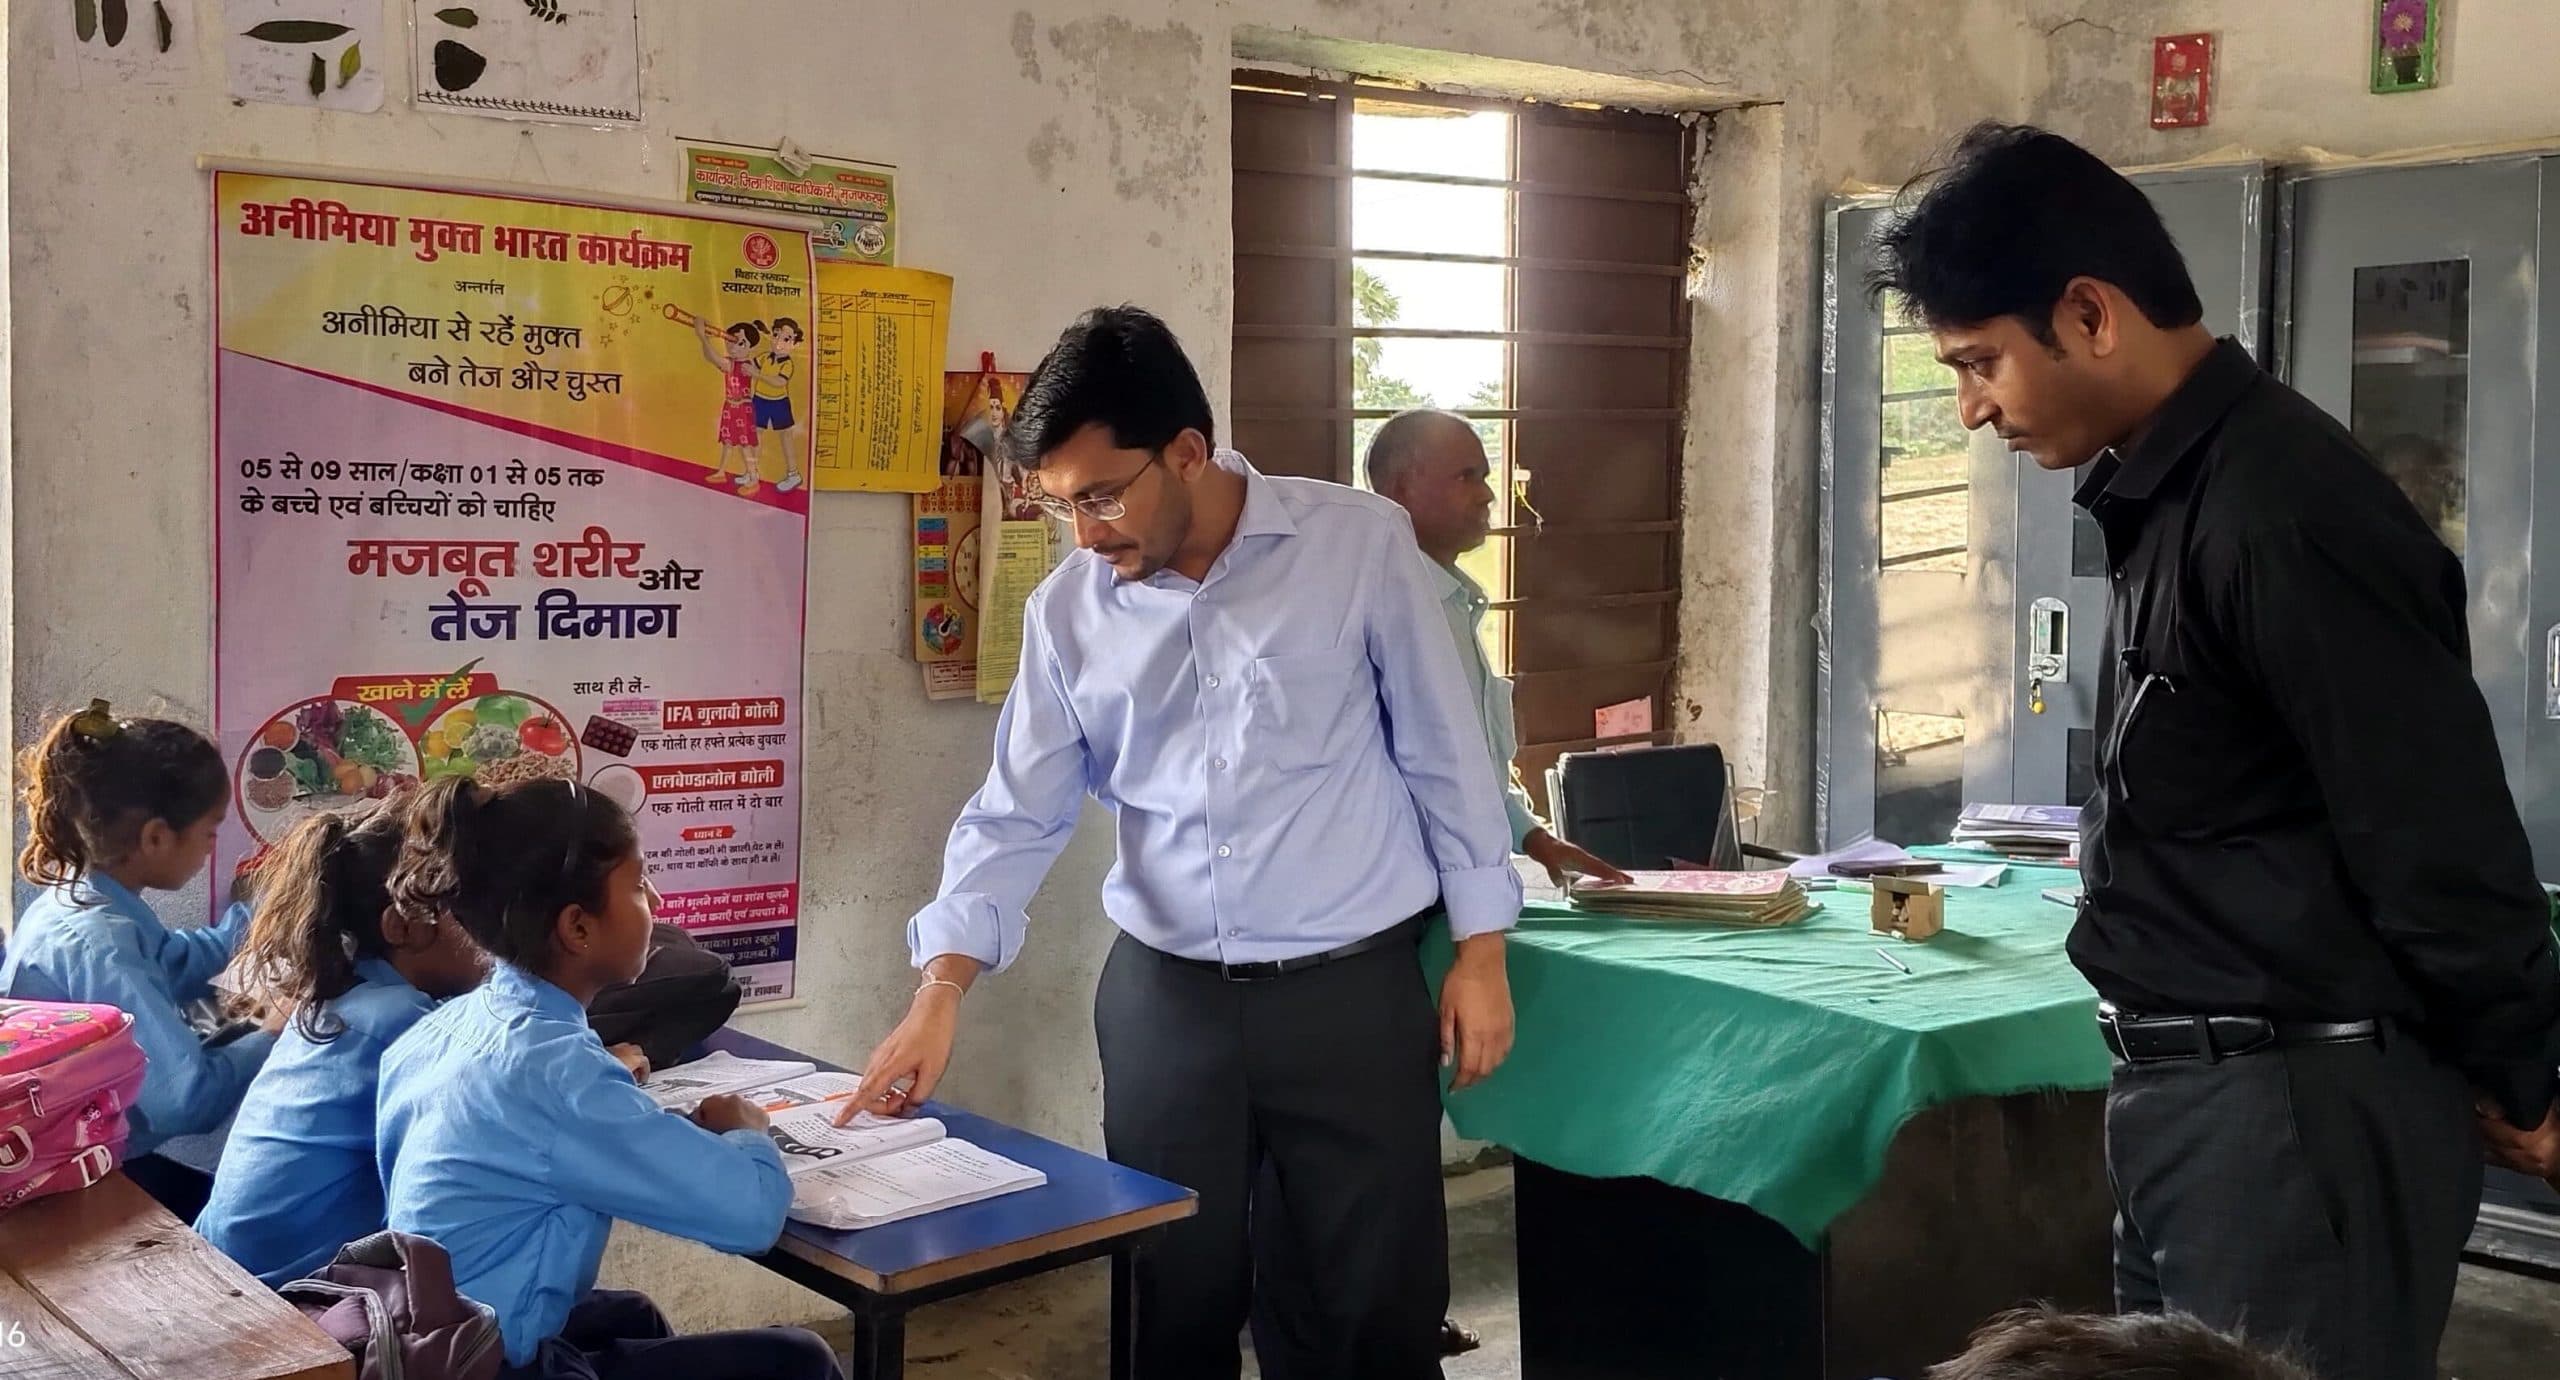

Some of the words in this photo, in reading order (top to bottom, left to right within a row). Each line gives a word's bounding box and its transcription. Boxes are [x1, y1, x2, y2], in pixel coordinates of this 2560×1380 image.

[240, 198, 399, 249] अनीमिया
[409, 217, 482, 263] मुक्त
[494, 224, 568, 261] भारत
[577, 229, 692, 272] कार्यक्रम
[454, 278, 505, 297] अन्तर्गत
[722, 282, 763, 295] स्वास्थ्य
[766, 282, 801, 297] विभाग
[322, 304, 438, 340] अनीमिया
[447, 309, 471, 343] से
[480, 314, 515, 348] रहें
[523, 322, 582, 356] मुक्त
[408, 354, 451, 387] बने
[458, 356, 504, 390] तेज
[511, 359, 560, 394] और
[566, 372, 623, 401] चुस्त
[241, 461, 271, 480] 05
[279, 453, 303, 481] से
[310, 461, 342, 481] 09
[470, 464, 497, 485] 01
[505, 458, 530, 486] से
[535, 466, 562, 486] 05
[569, 466, 605, 488] तक
[240, 487, 265, 517] के
[271, 490, 319, 518] बच्चे
[329, 490, 364, 520] एवं
[369, 490, 452, 518] बच्चियों
[457, 496, 489, 519] को
[494, 496, 556, 522] चाहिए
[347, 540, 519, 597] मजबूत
[534, 526, 646, 578] शरीर
[639, 559, 703, 591] और
[429, 590, 521, 641] तेज
[534, 588, 682, 640] दिमाग
[355, 679, 417, 701] खाने
[421, 677, 446, 699] में
[448, 675, 475, 699] लें
[573, 681, 604, 696] साथ
[608, 677, 624, 695] ही
[666, 706, 693, 722] IFA
[744, 700, 779, 719] गोली
[641, 740, 659, 753] एक
[662, 735, 687, 751] गोली
[690, 737, 701, 750] हर
[704, 732, 725, 748] हफ्ते
[740, 766, 776, 784] गोली
[651, 802, 673, 816] एक
[676, 797, 705, 813] गोली
[708, 799, 733, 811] साल
[737, 794, 746, 809] में
[749, 793, 762, 808] दो
[764, 796, 783, 807] बार
